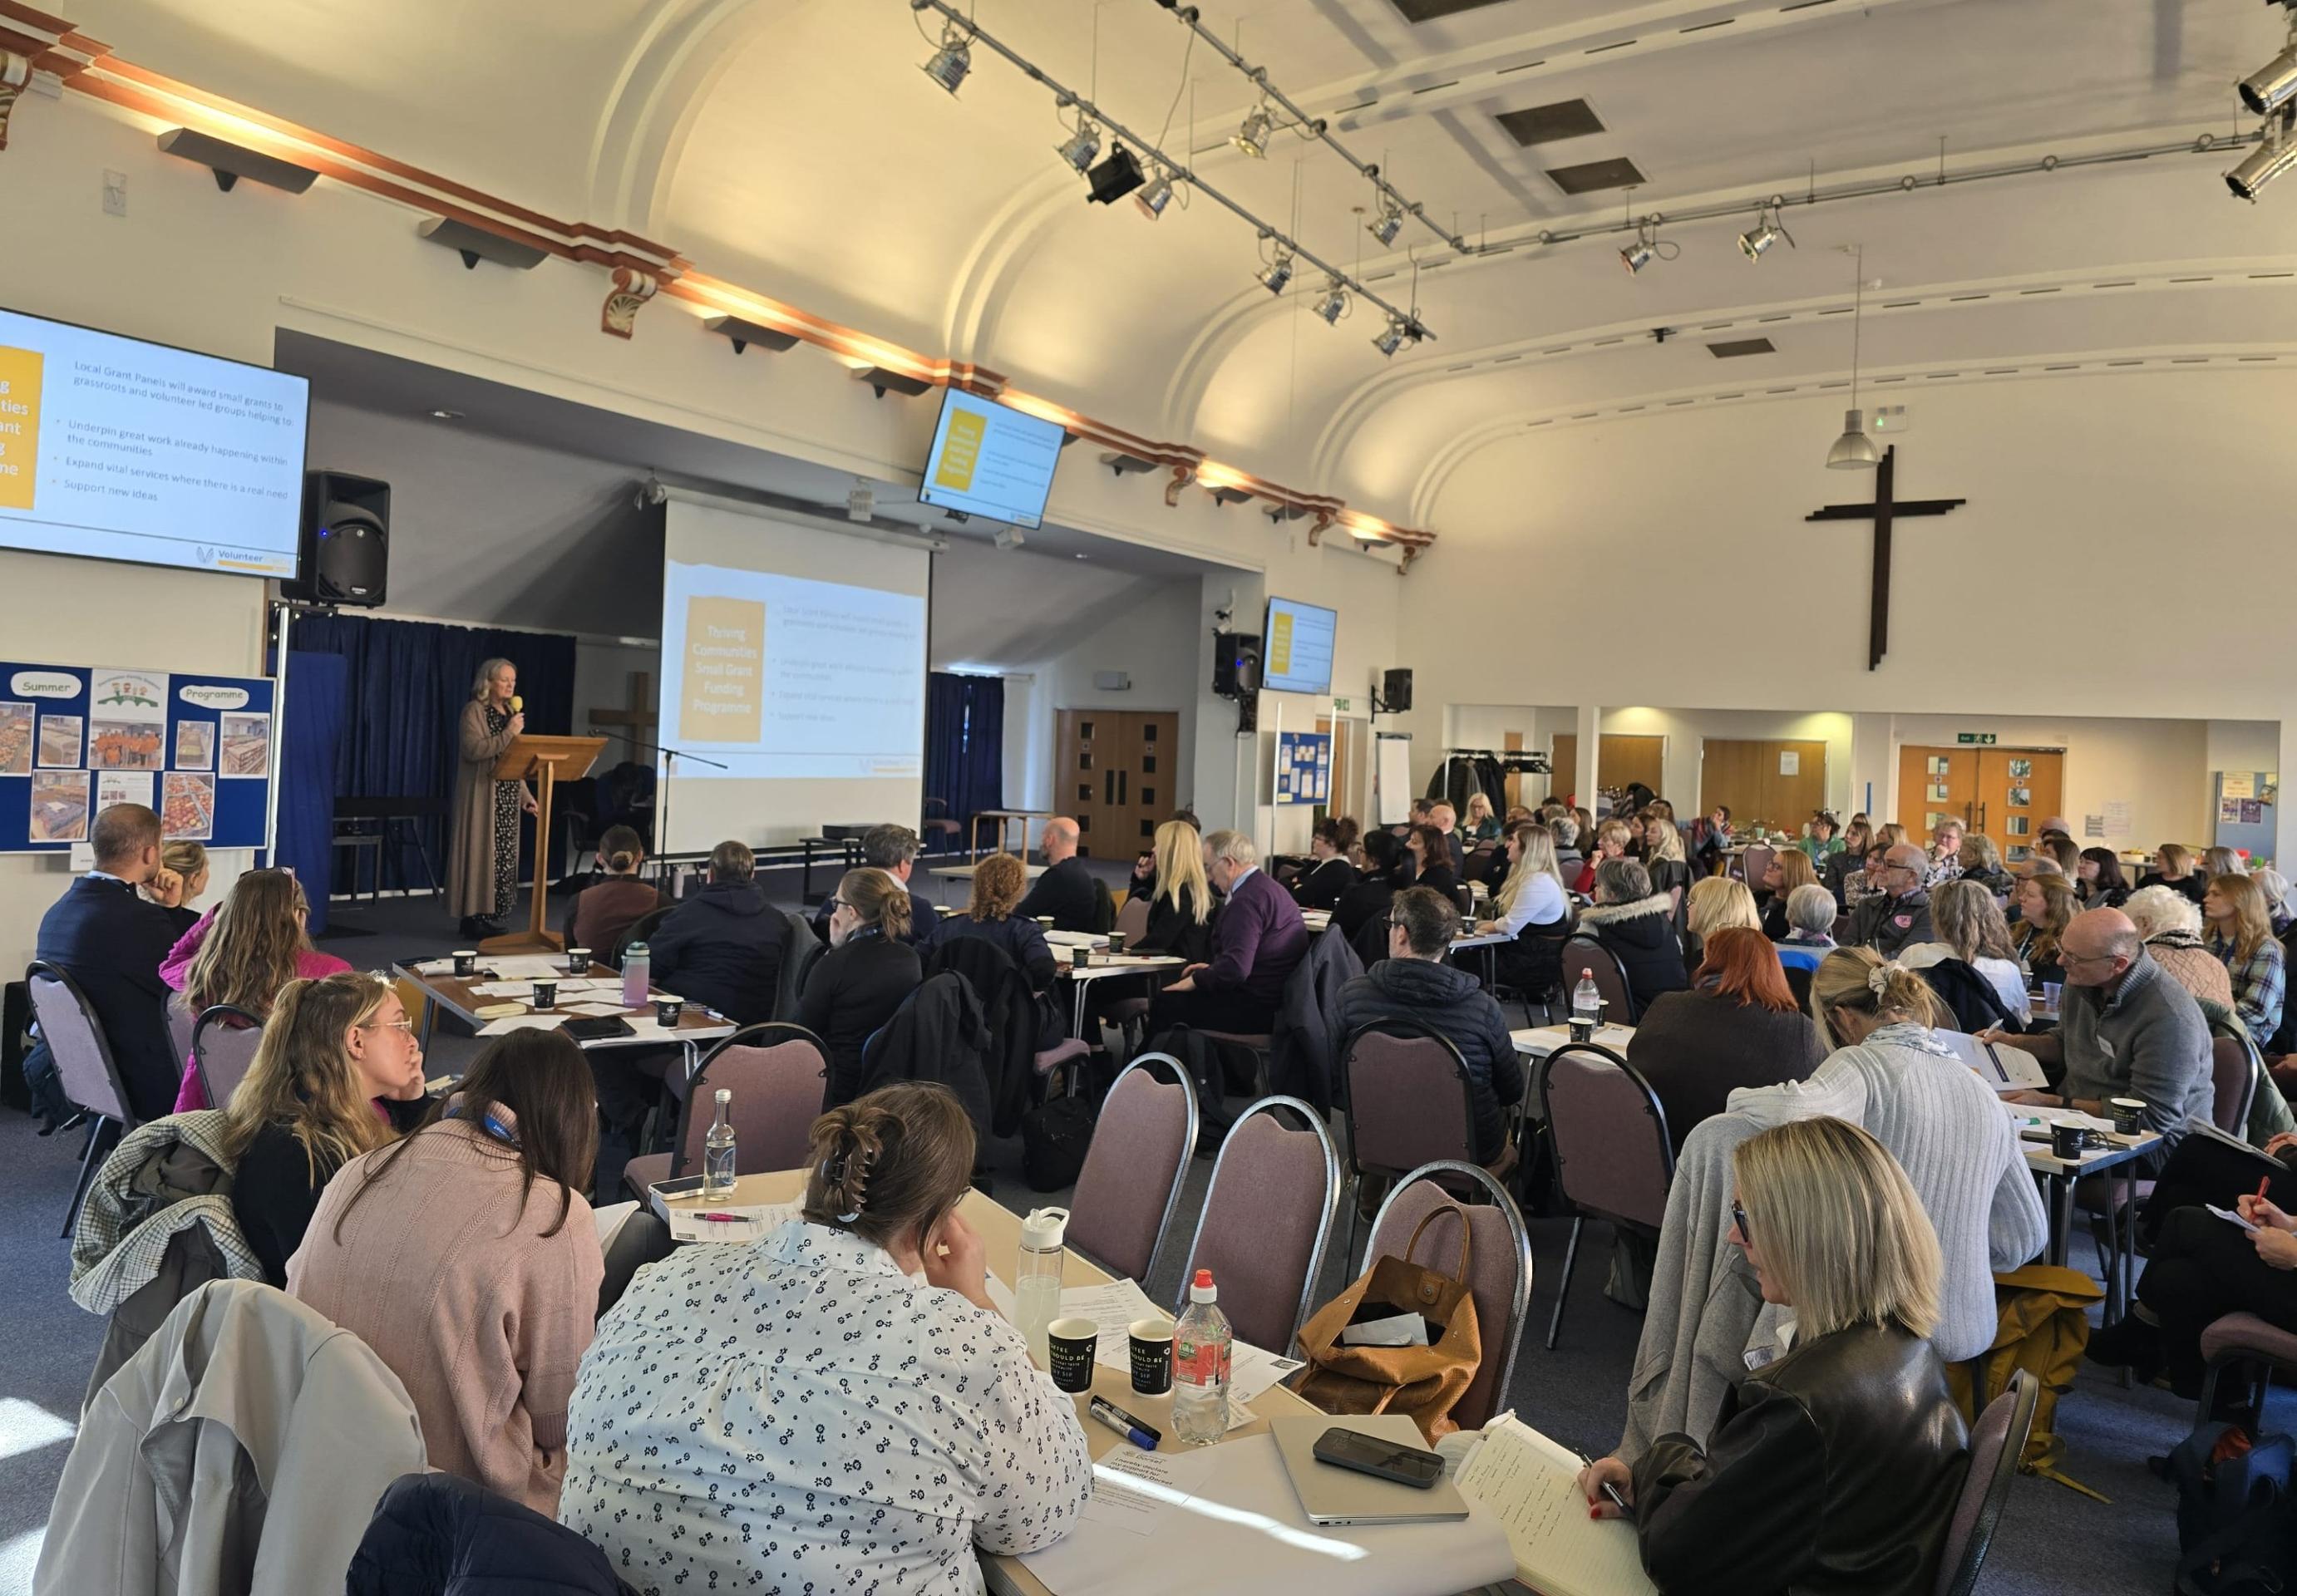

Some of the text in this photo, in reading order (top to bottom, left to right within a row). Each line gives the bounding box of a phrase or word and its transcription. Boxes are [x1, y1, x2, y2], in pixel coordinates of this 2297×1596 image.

[75, 361, 283, 411] Local Grant Panels will award small grants to
[74, 377, 126, 393] grassroots
[129, 386, 147, 397] and
[150, 392, 195, 406] volunteer
[200, 401, 212, 410] led
[215, 405, 246, 418] groups
[249, 411, 281, 426] helping
[67, 434, 153, 456] the communities
[68, 419, 288, 466] Underpin great work already happening within
[66, 456, 288, 500] Expand vital services where there is a real need
[64, 479, 158, 501] Support new ideas
[219, 549, 264, 562] Volunteer
[693, 643, 757, 659] Communities
[695, 663, 752, 677] Small Grant
[22, 682, 71, 692] Summer
[186, 688, 244, 701] Programme
[705, 681, 745, 697] Funding
[693, 699, 752, 717] Programme
[1136, 1455, 1163, 1465] Dorset
[1149, 1475, 1173, 1485] Dorset
